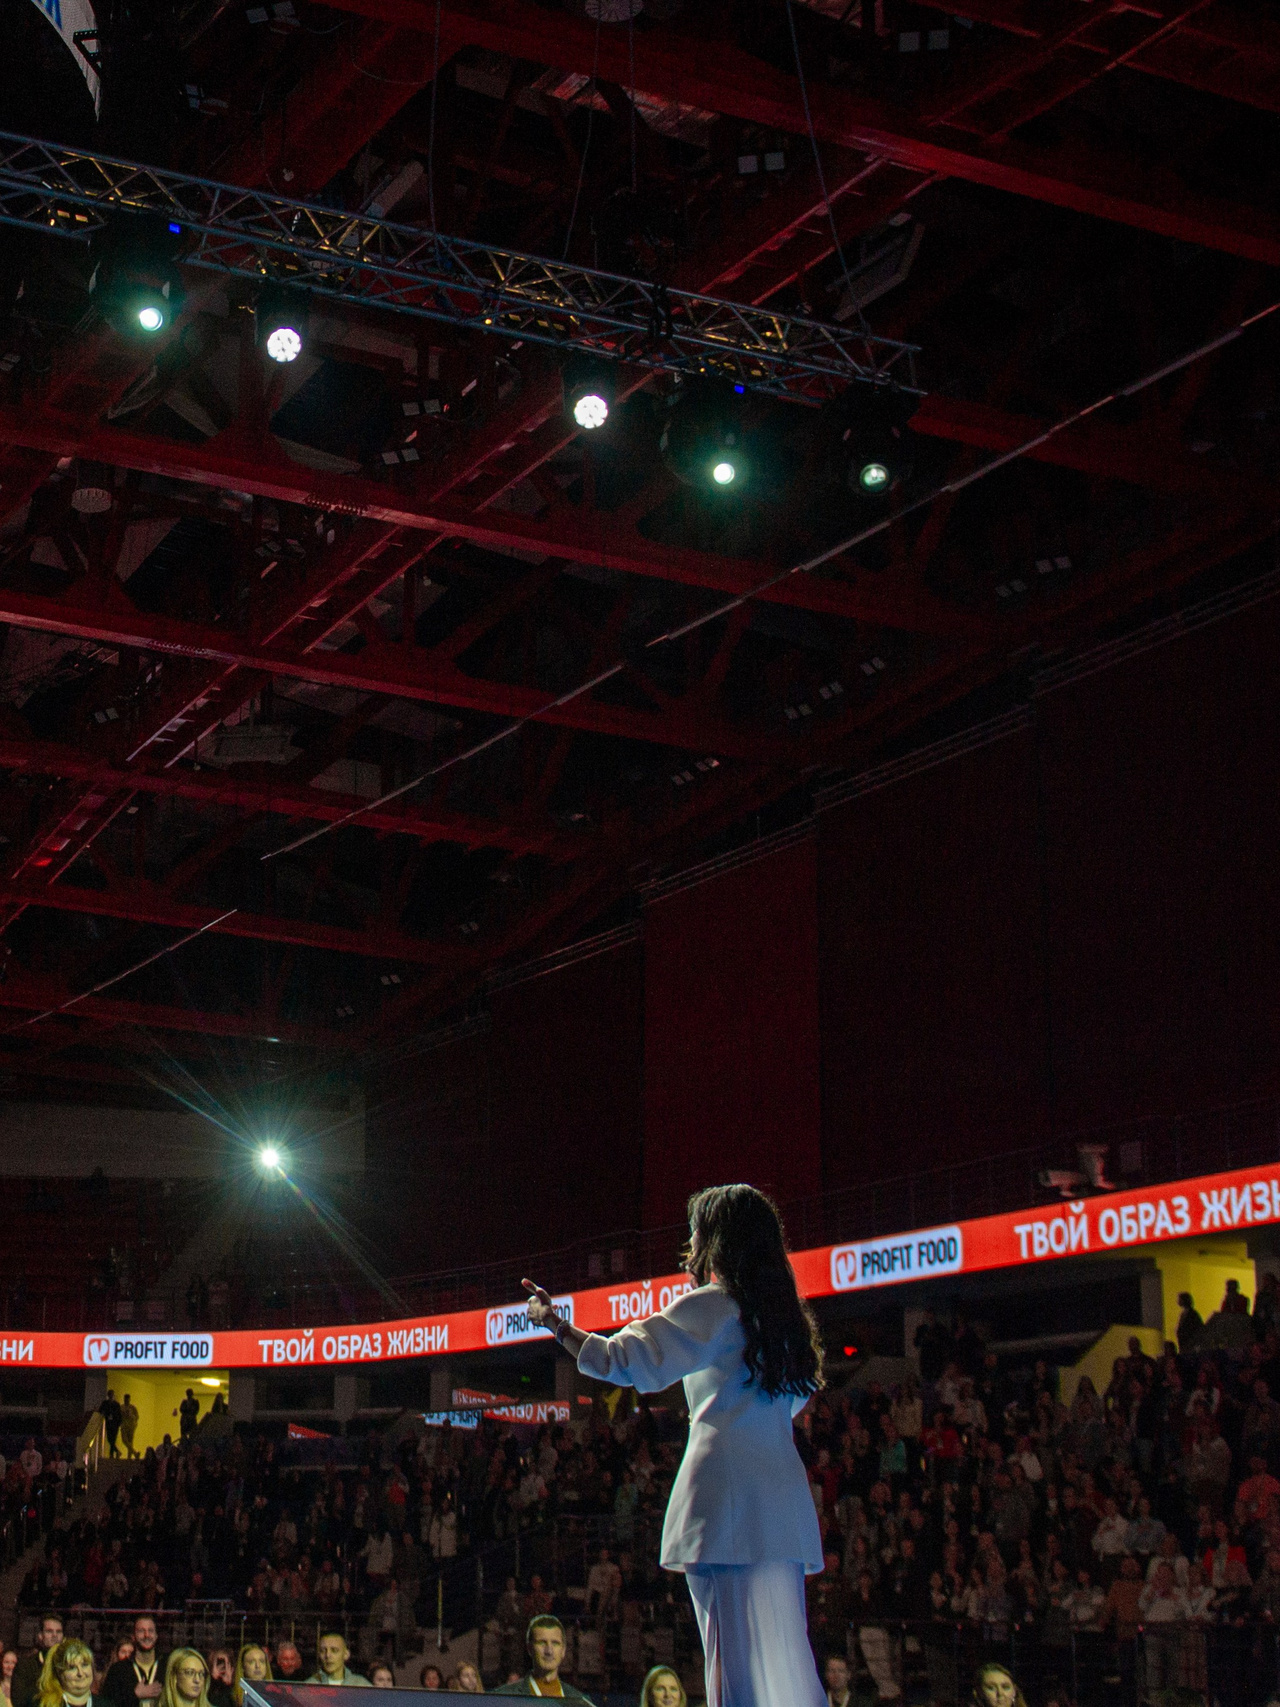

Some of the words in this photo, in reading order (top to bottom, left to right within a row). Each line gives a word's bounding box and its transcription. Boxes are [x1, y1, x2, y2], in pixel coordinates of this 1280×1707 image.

[1014, 1201, 1089, 1259] ТВОЙ
[1099, 1196, 1191, 1245] ОБРАЗ
[861, 1244, 912, 1276] PROFIT
[918, 1236, 957, 1266] FOOD
[608, 1280, 653, 1321] ТВОЙ
[114, 1341, 167, 1359] PROFIT
[171, 1341, 209, 1359] FOOD
[258, 1328, 315, 1363] ТВОЙ
[322, 1332, 382, 1361] ОБРАЗ
[387, 1324, 449, 1356] ЖИЗНИ
